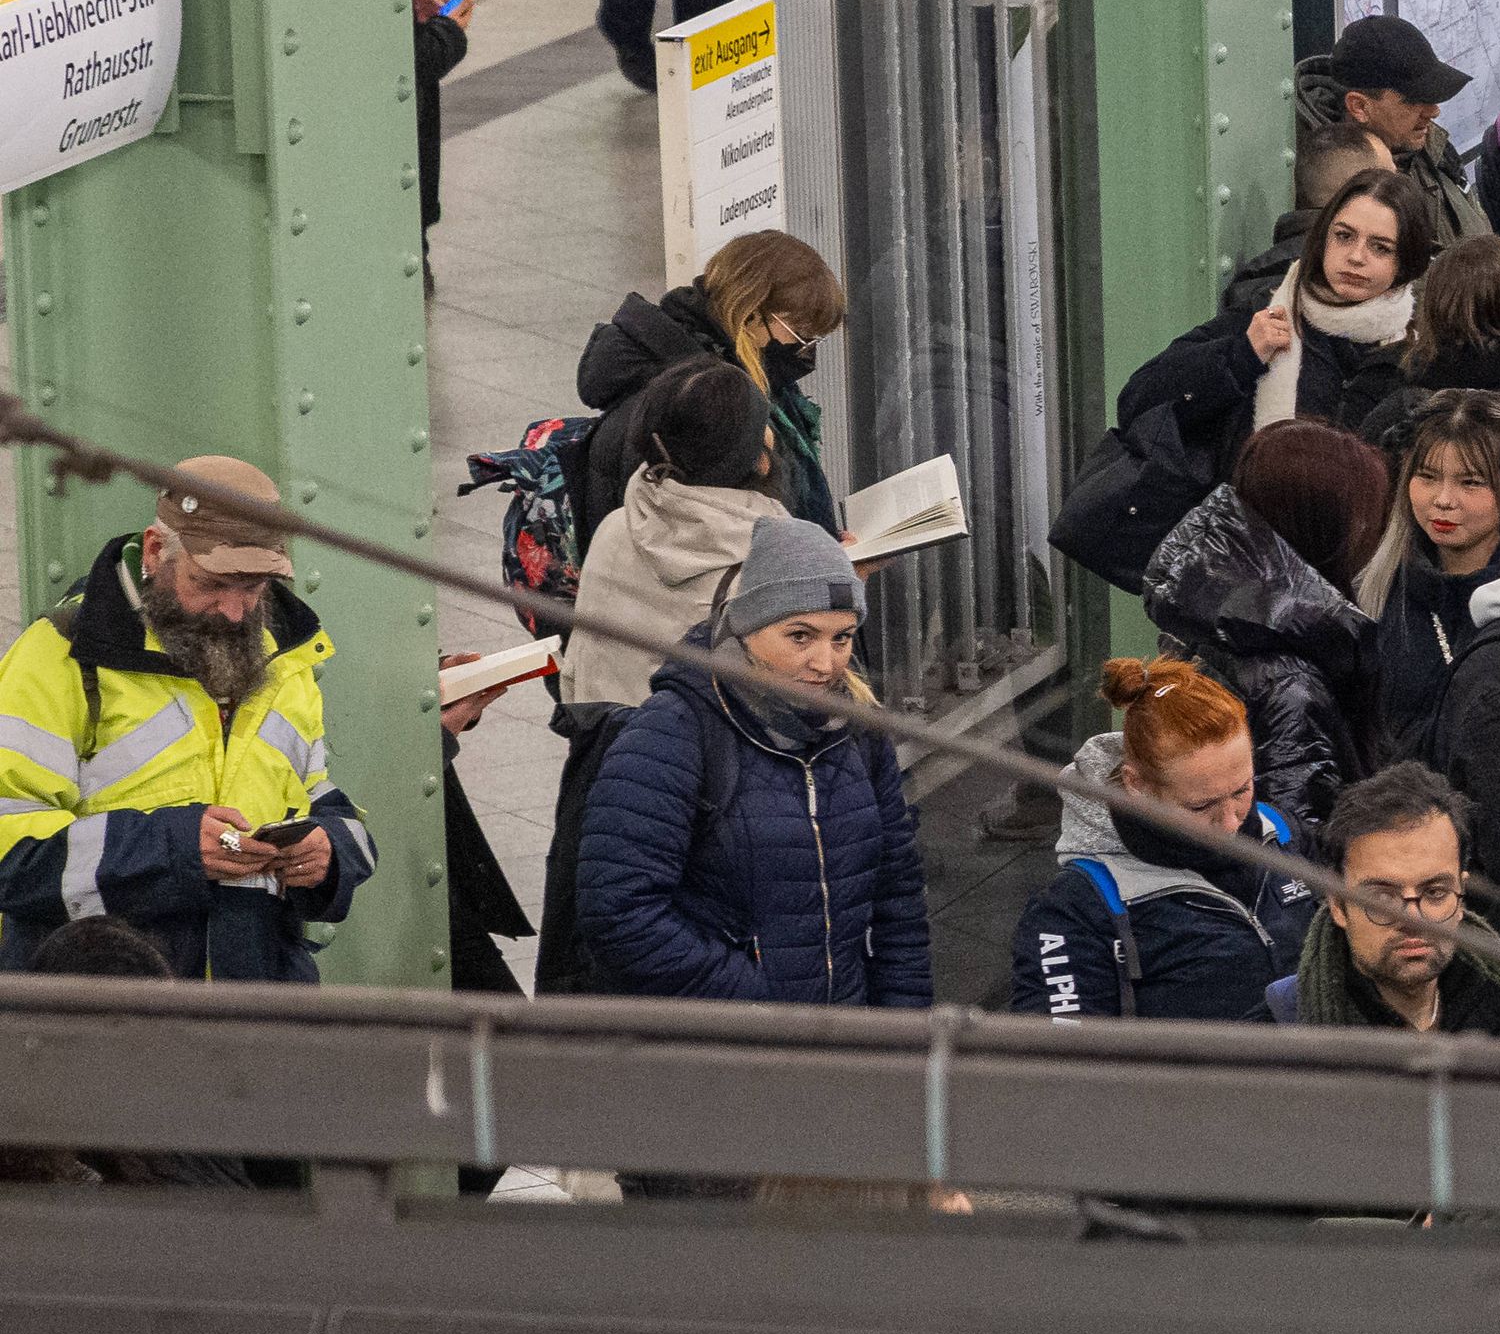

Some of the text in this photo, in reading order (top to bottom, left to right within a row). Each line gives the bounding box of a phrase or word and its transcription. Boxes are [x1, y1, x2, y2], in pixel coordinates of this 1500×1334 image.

[62, 37, 154, 101] Rathausstr.
[693, 30, 759, 76] exit Ausgang
[730, 62, 773, 94] Polizeiwache
[58, 97, 143, 154] Grunerstr.
[725, 86, 774, 121] Alexanderplatz
[720, 123, 776, 170] Nikolaiviertel
[719, 182, 778, 227] Ladenpassage
[1027, 241, 1040, 320] SWAROVSKI
